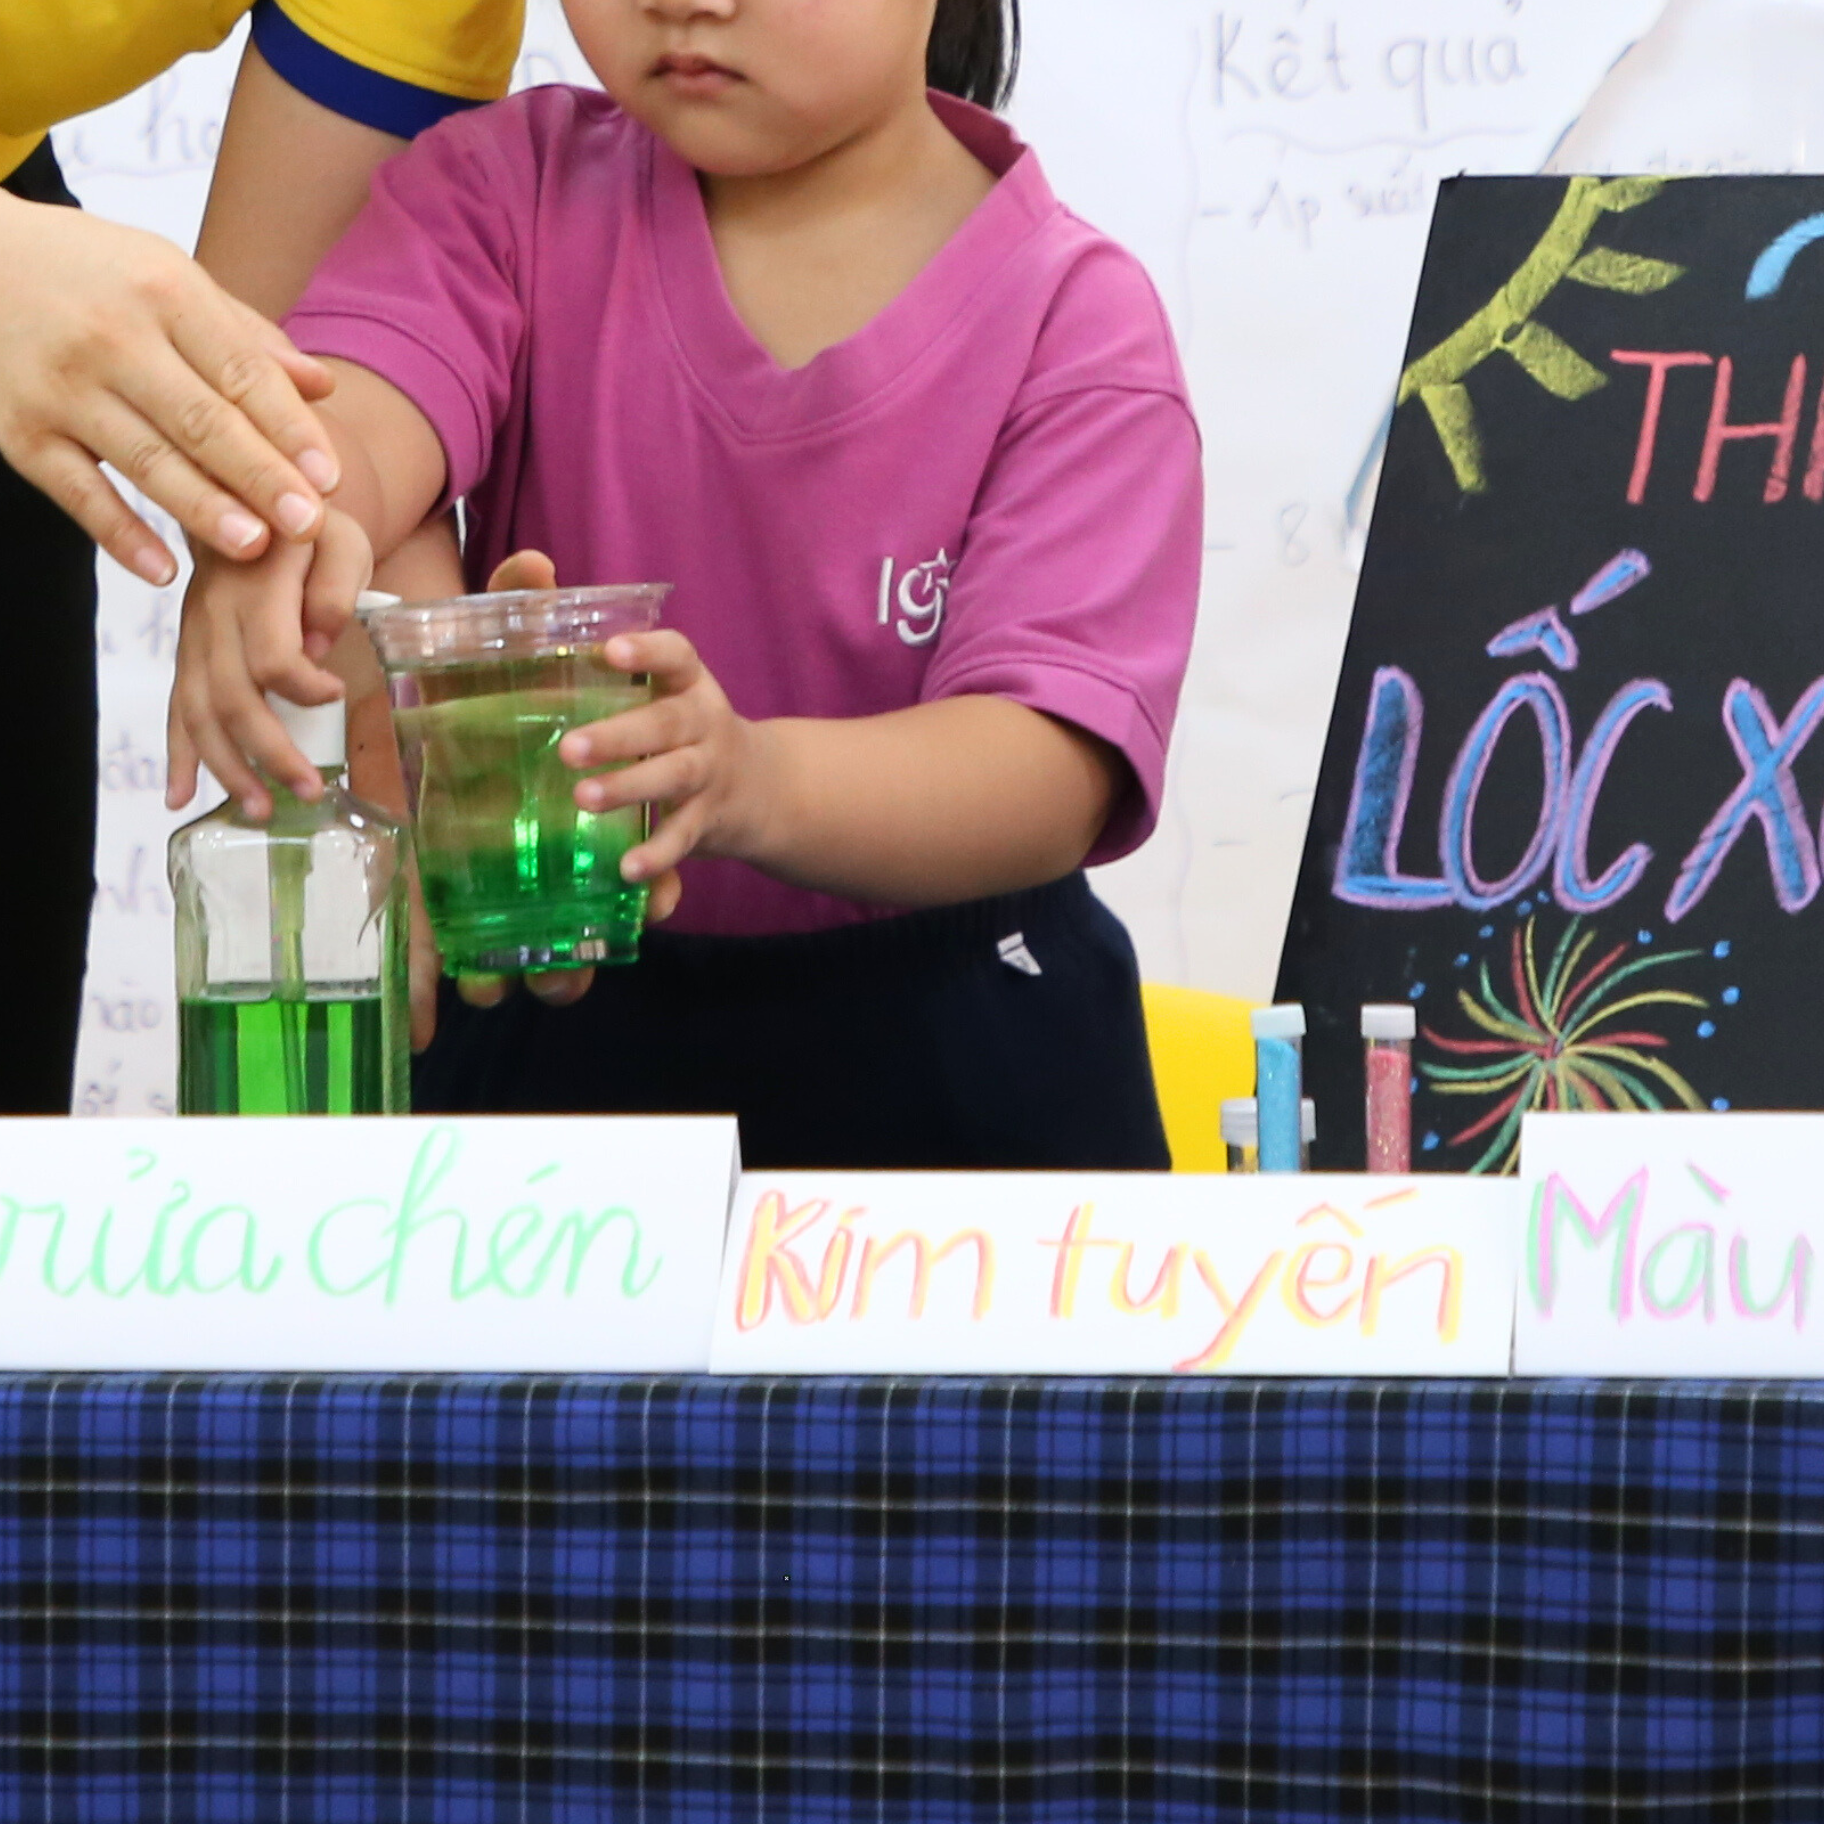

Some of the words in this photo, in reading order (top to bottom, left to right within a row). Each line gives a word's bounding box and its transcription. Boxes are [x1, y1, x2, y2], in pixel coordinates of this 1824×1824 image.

[1332, 549, 1673, 917] LỐC
[306, 1125, 662, 1311] chén
[735, 1186, 997, 1334] Kim
[1036, 1186, 1462, 1373] tuyến
[1527, 1160, 1816, 1336] Màu
